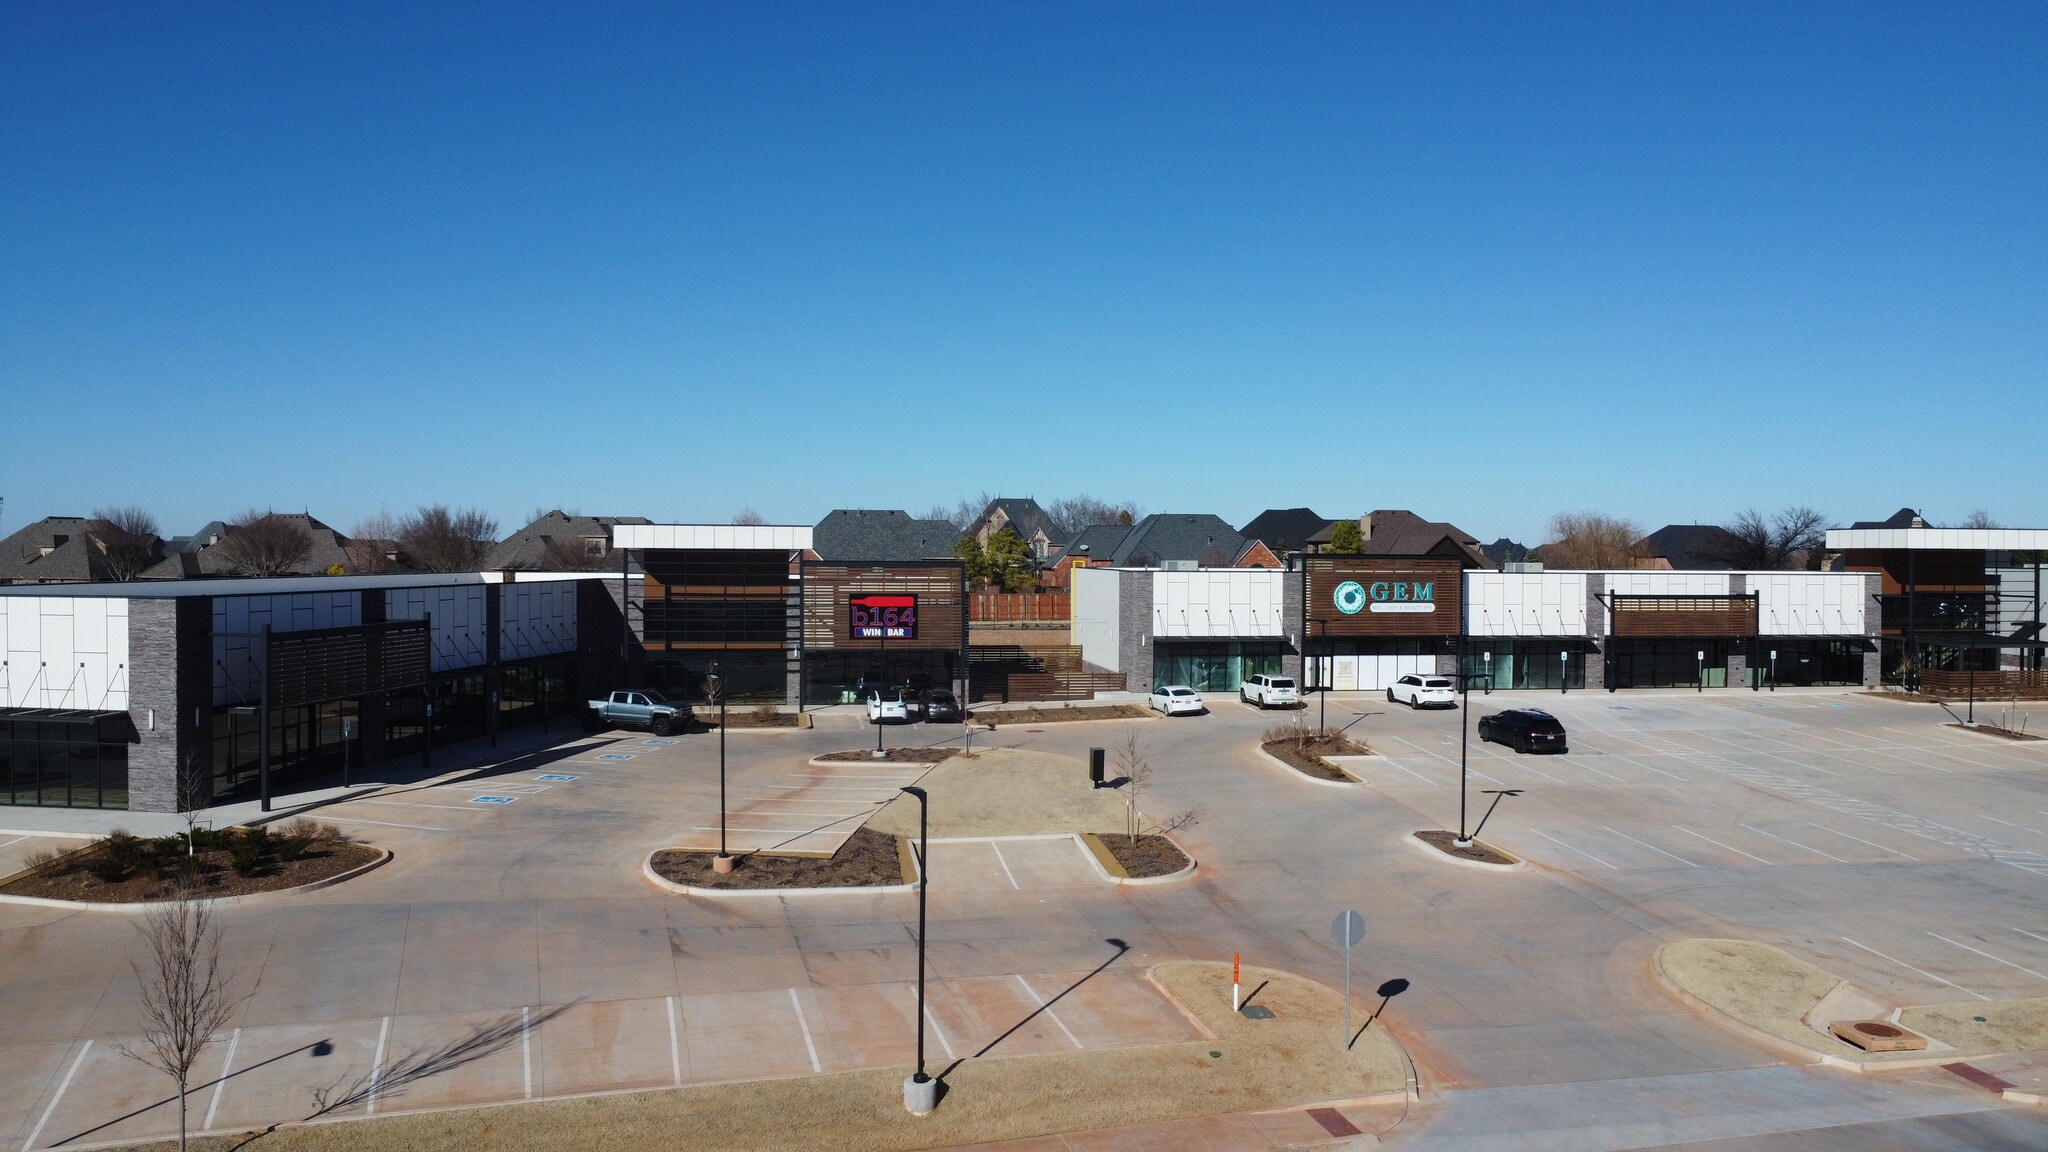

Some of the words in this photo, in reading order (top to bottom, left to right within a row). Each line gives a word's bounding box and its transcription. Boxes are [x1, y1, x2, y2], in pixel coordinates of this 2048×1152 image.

[1370, 581, 1434, 601] GEM
[851, 606, 916, 626] b164
[887, 628, 905, 636] BAR
